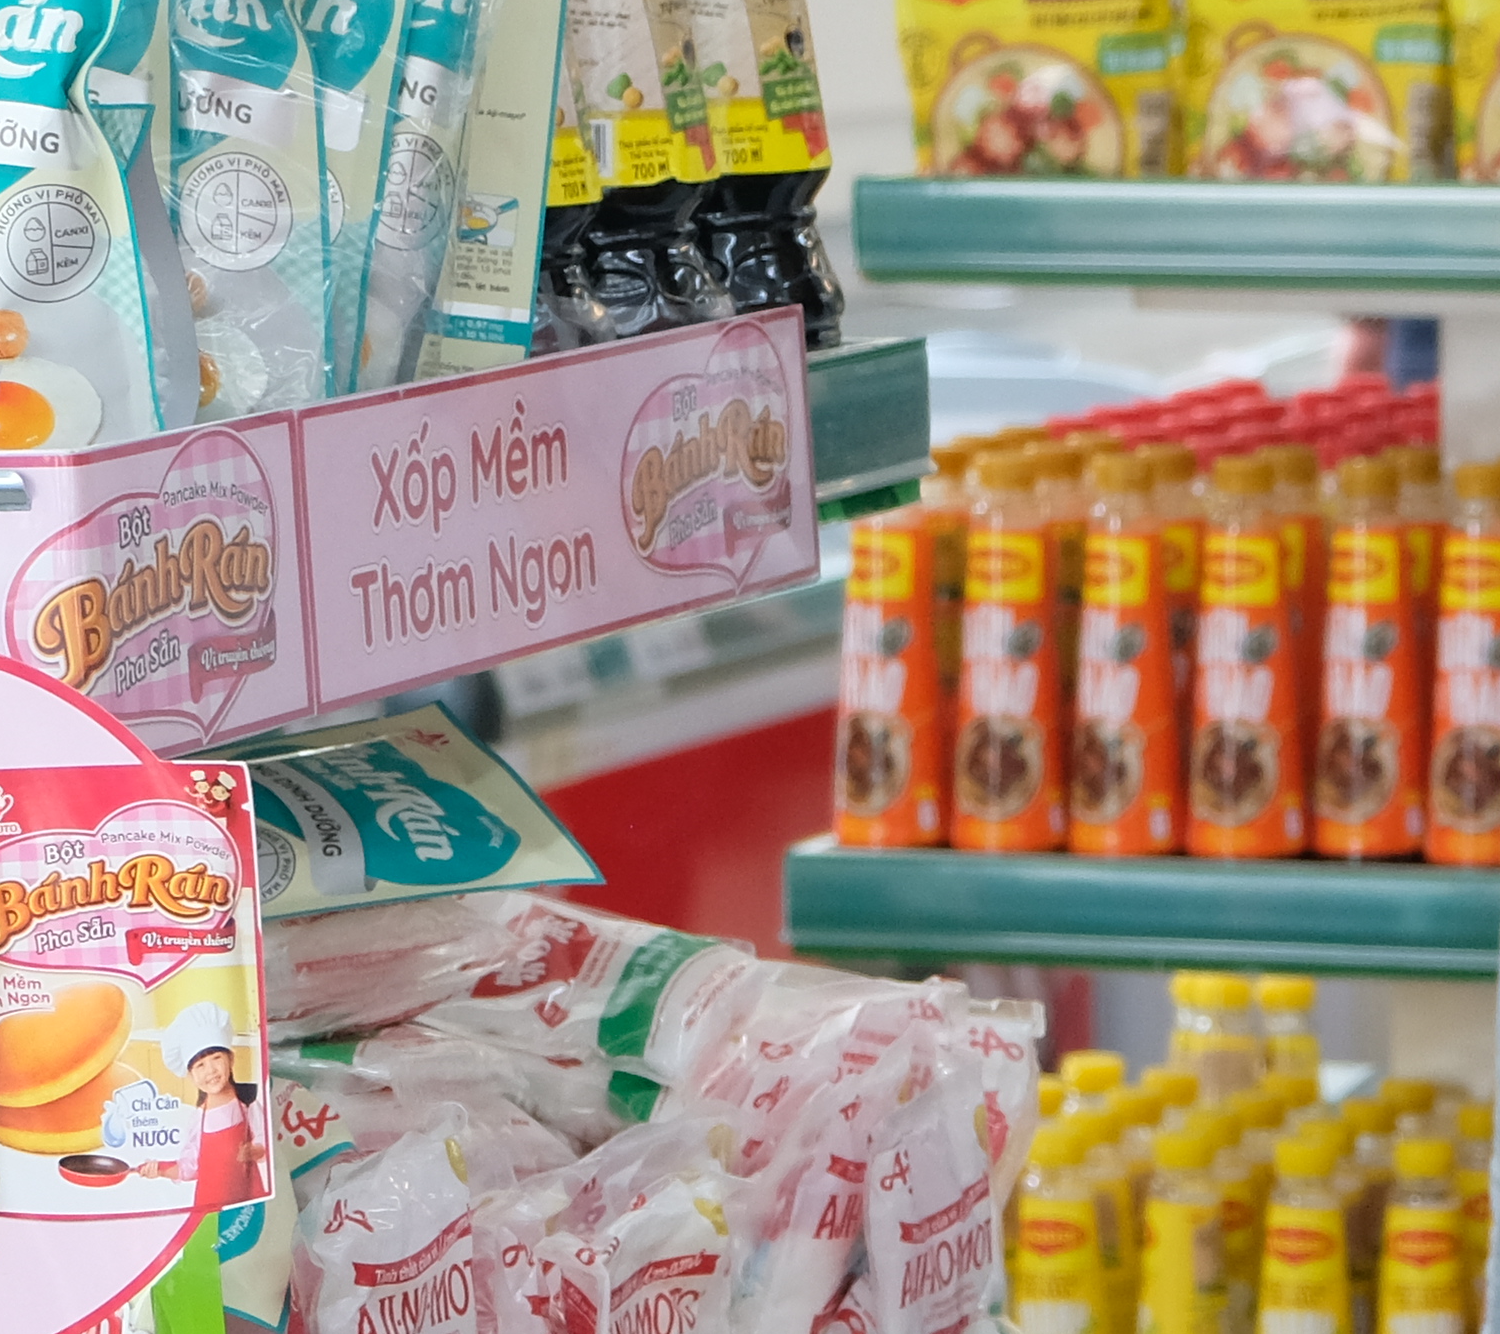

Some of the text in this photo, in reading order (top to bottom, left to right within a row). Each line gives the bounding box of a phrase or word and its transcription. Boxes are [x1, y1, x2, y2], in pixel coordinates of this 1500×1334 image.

[372, 399, 568, 534] Xốp Mềm
[351, 532, 597, 648] Thơm Ngon
[44, 841, 85, 866] Bột
[35, 917, 115, 955] Pha Sẵn
[132, 1128, 180, 1147] NƯỚC
